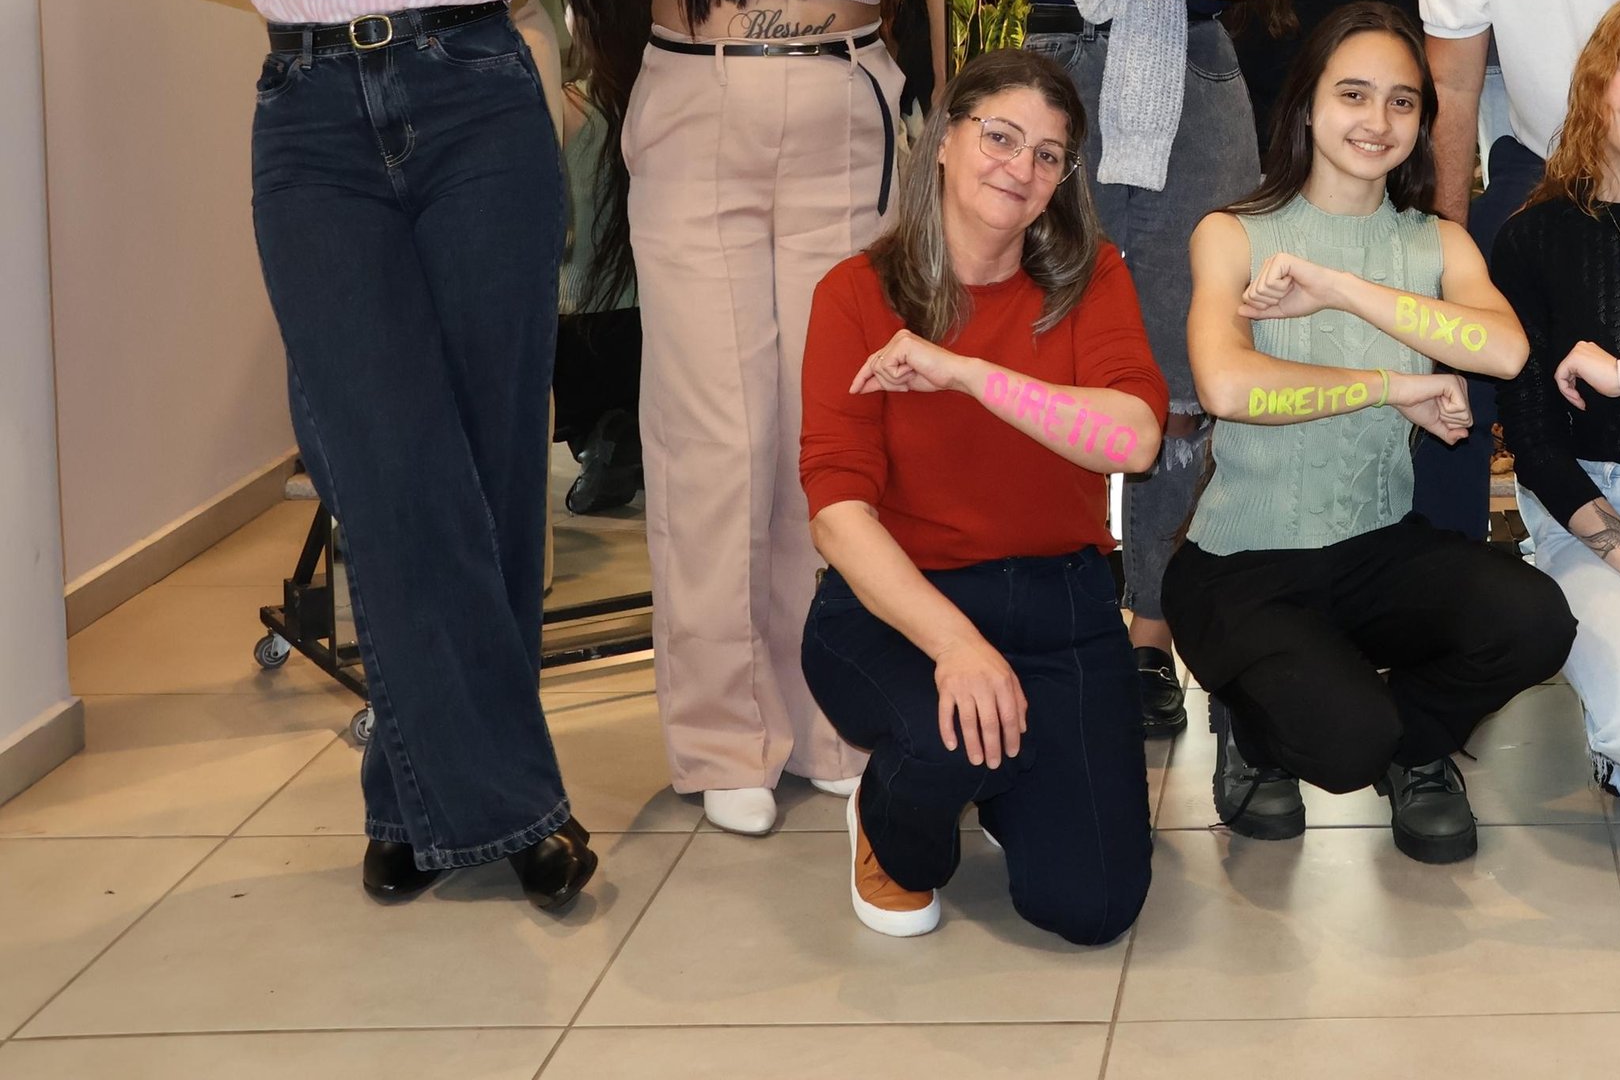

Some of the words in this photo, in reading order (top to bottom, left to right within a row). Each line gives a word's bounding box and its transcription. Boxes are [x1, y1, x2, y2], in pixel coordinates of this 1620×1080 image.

[728, 9, 837, 40] Blessed
[1393, 295, 1488, 352] BIXO
[982, 370, 1139, 464] DIREITO
[1249, 381, 1369, 418] DIREITO
